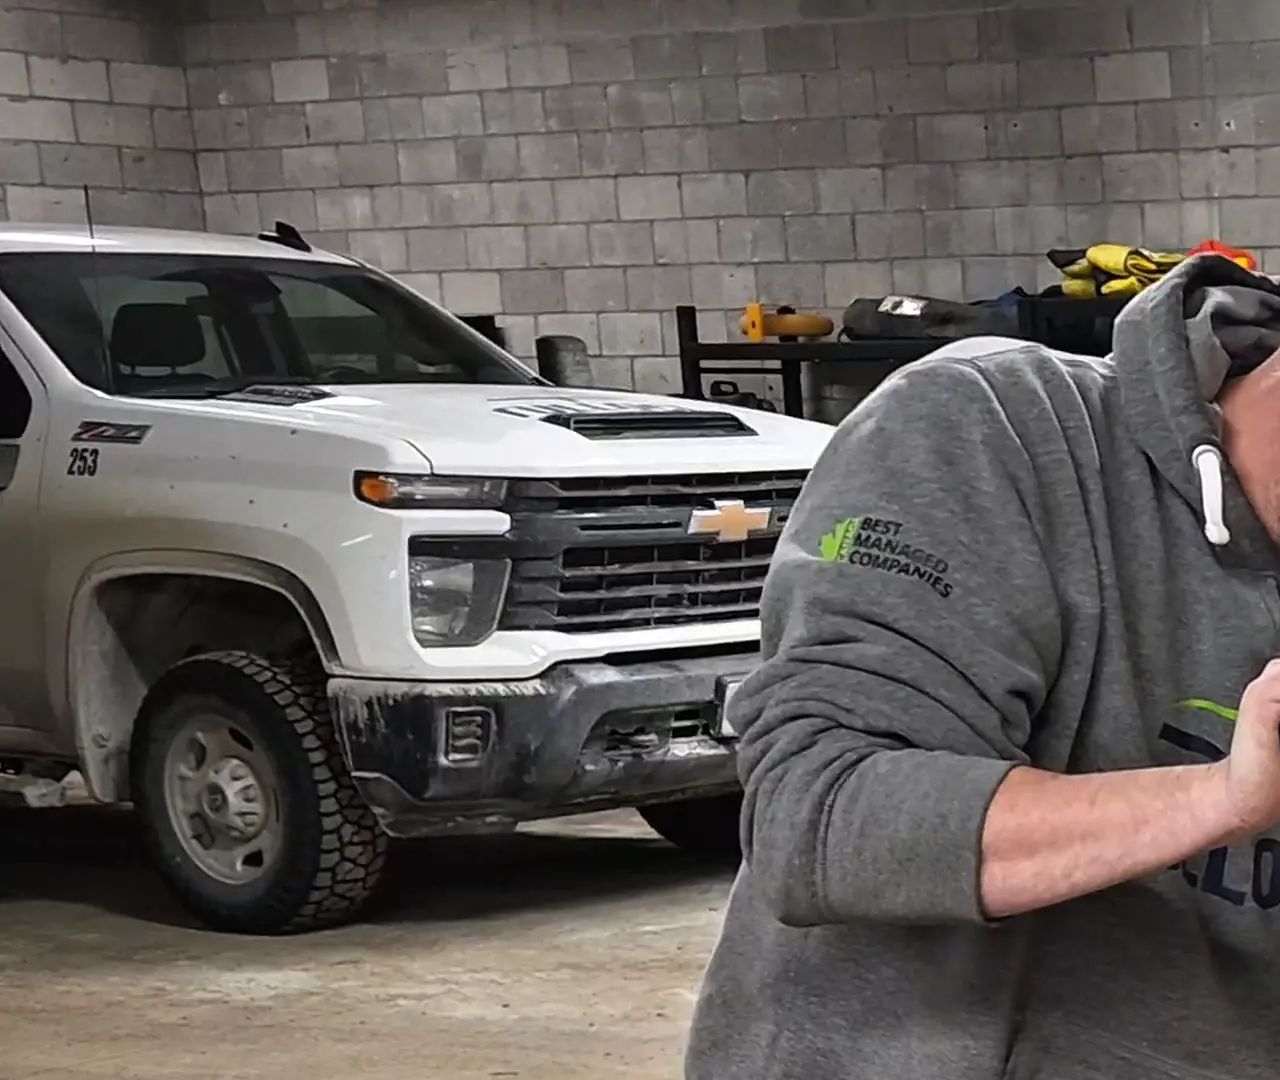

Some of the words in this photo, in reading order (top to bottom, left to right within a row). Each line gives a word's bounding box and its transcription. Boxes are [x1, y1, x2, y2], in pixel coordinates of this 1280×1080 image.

[66, 447, 100, 477] 253
[860, 517, 903, 537] BEST
[853, 533, 949, 574] MANAGED
[848, 550, 953, 598] COMPANIES
